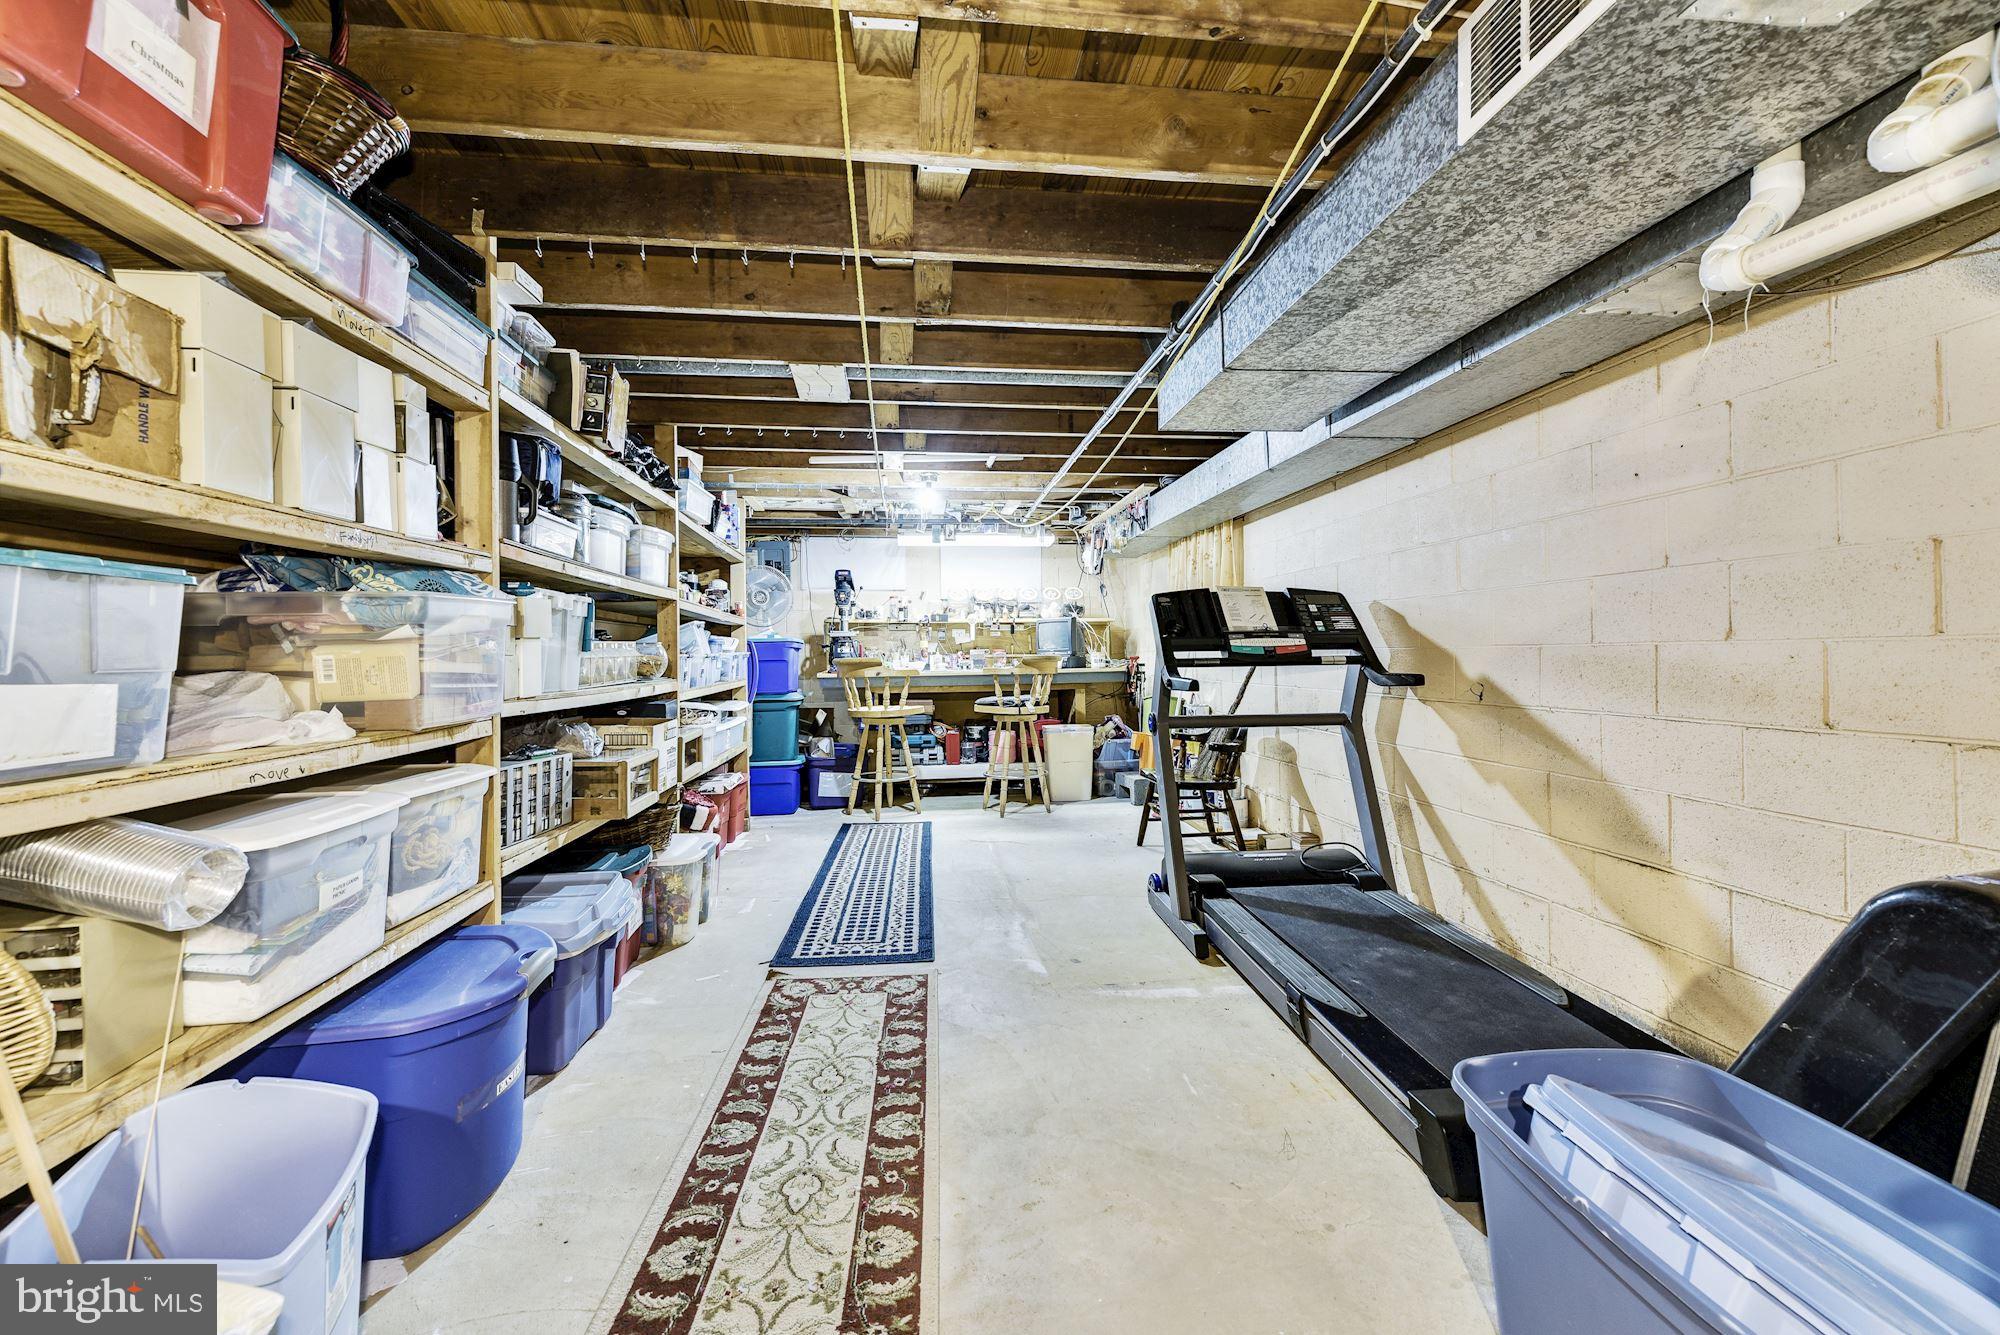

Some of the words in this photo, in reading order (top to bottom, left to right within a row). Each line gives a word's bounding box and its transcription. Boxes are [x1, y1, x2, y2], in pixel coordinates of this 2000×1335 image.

[130, 39, 184, 89] Christmas
[138, 402, 149, 443] HANDLE
[249, 767, 289, 784] move
